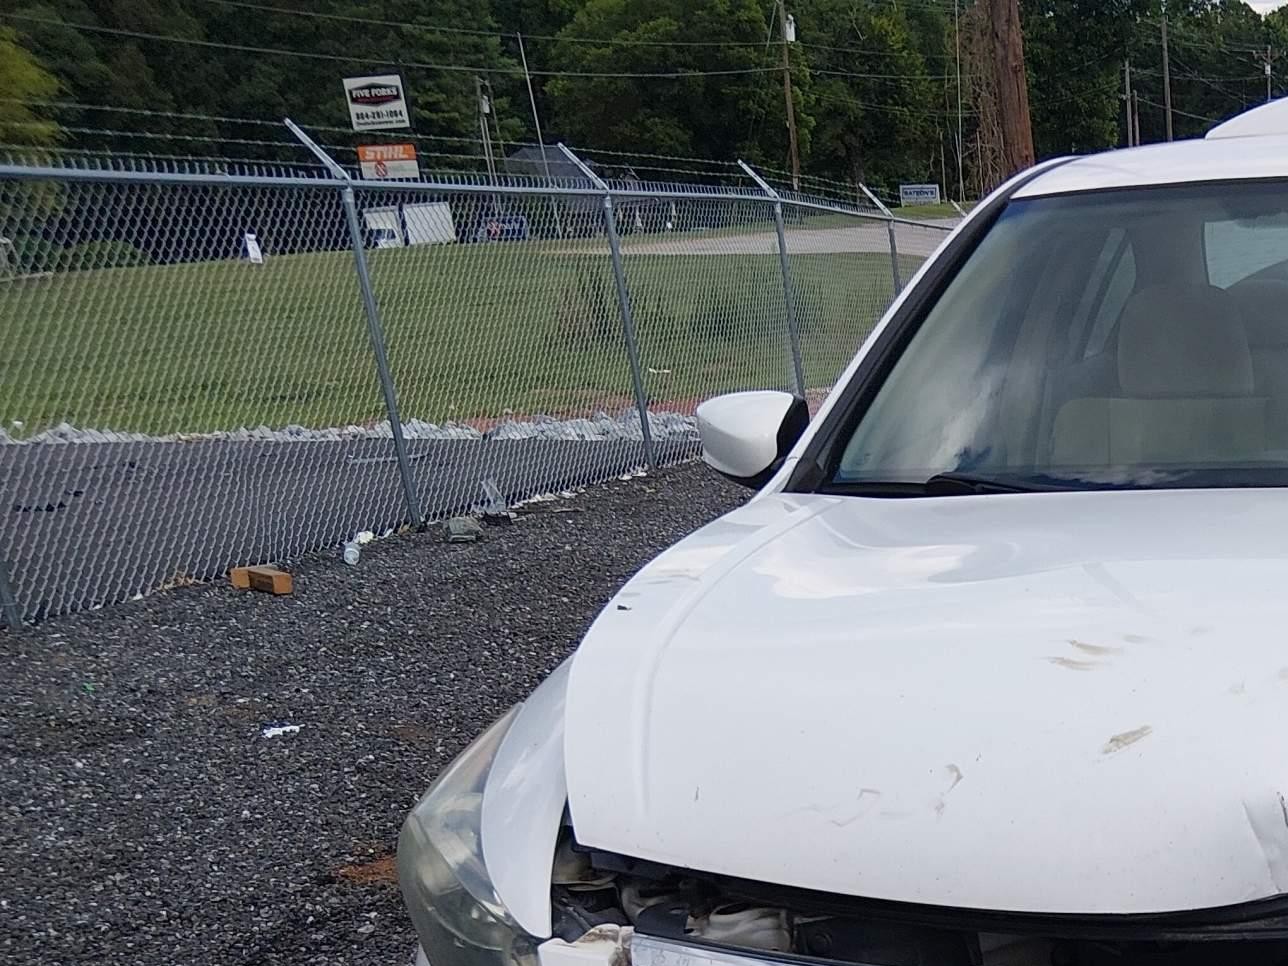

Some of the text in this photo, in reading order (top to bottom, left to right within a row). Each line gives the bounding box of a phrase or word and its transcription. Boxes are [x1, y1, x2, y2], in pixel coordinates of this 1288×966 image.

[352, 87, 398, 98] FIVE FORKS
[364, 144, 410, 160] STIHL
